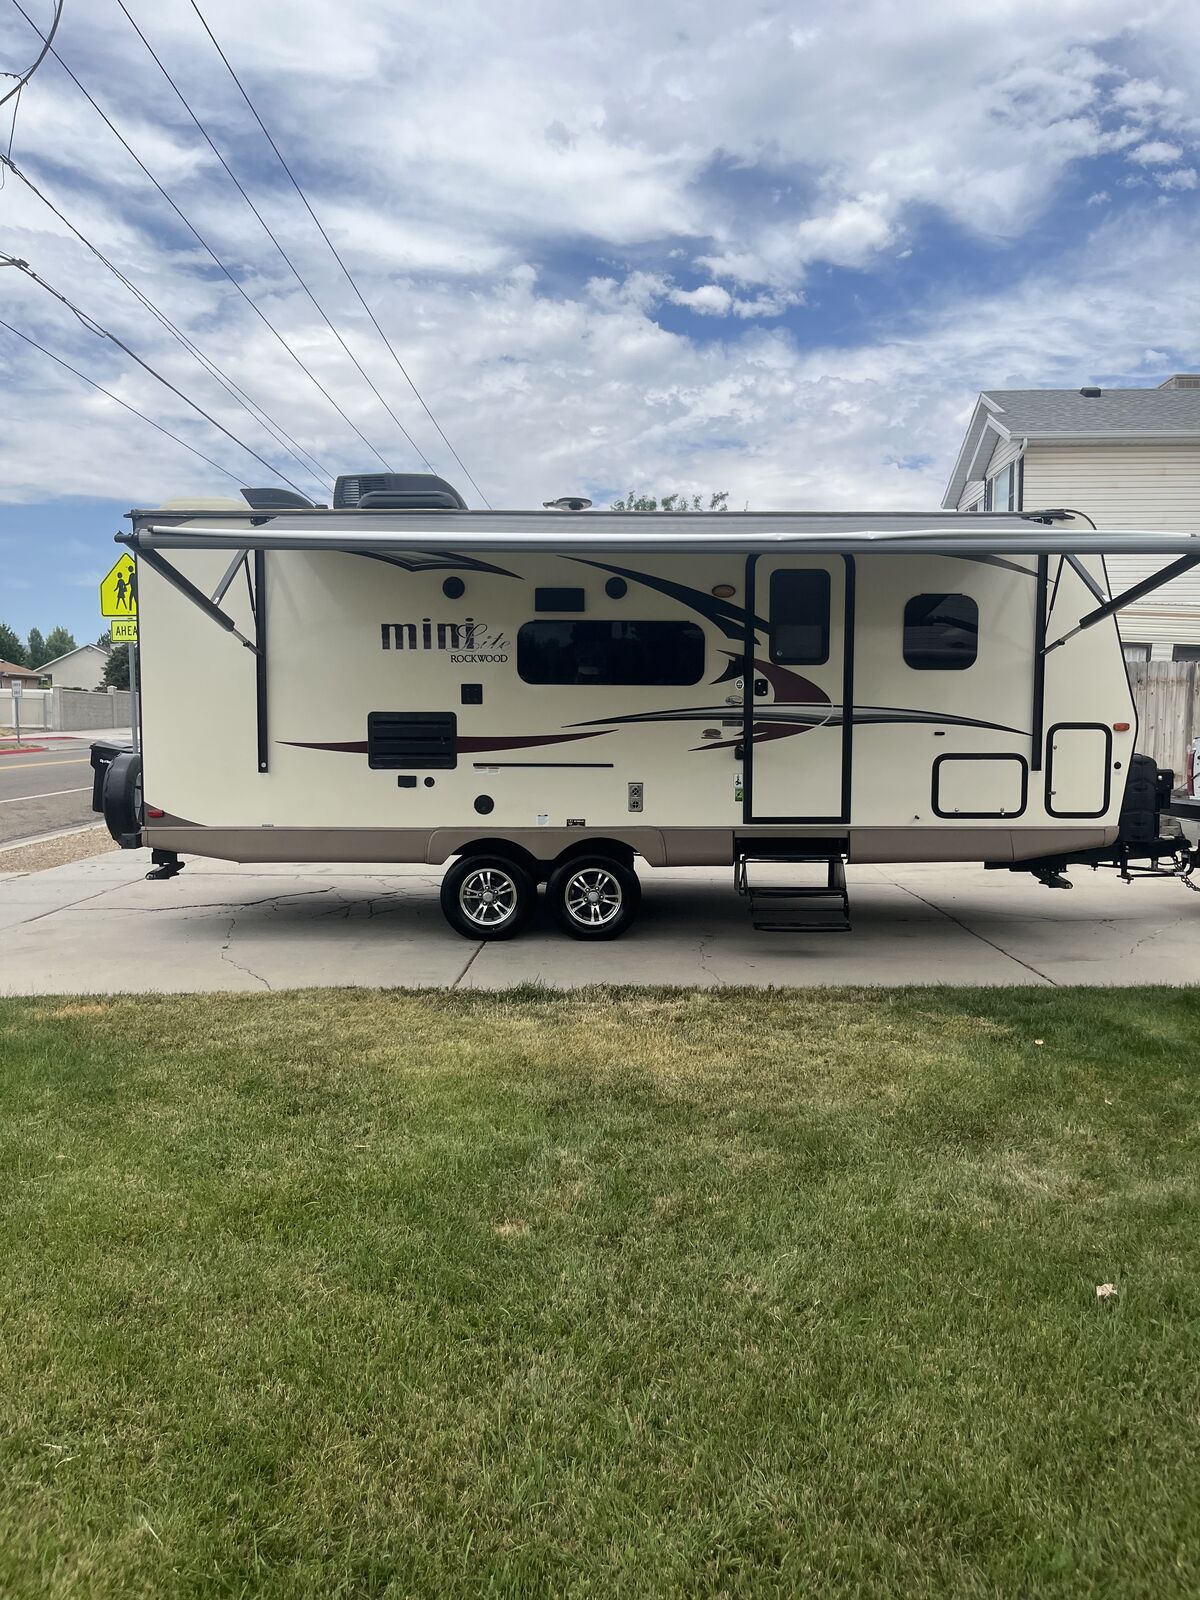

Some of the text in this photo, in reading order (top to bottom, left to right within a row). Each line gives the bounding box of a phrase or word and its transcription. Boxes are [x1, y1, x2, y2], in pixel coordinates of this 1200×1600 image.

[115, 625, 137, 636] AHEA
[381, 618, 511, 653] mini Lite
[450, 654, 508, 663] ROCKWOOD
